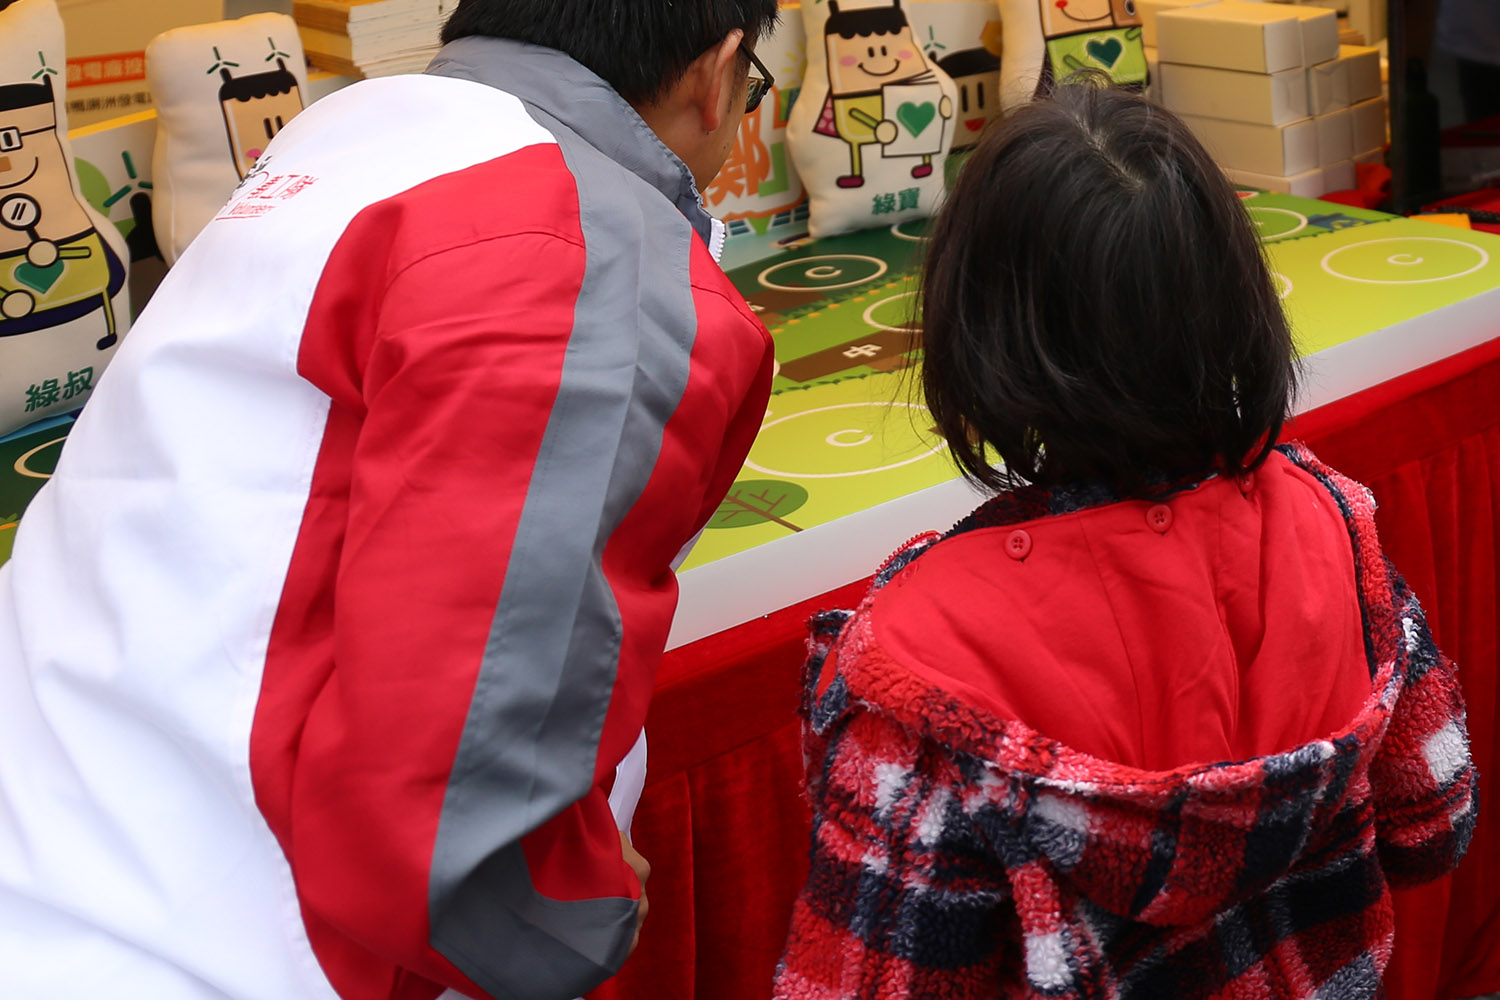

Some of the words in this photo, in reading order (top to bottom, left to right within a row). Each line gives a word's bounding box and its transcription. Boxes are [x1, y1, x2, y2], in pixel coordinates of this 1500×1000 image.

[872, 187, 920, 215] 綠寶
[842, 344, 882, 358] 中
[24, 366, 93, 413] 綠叔
